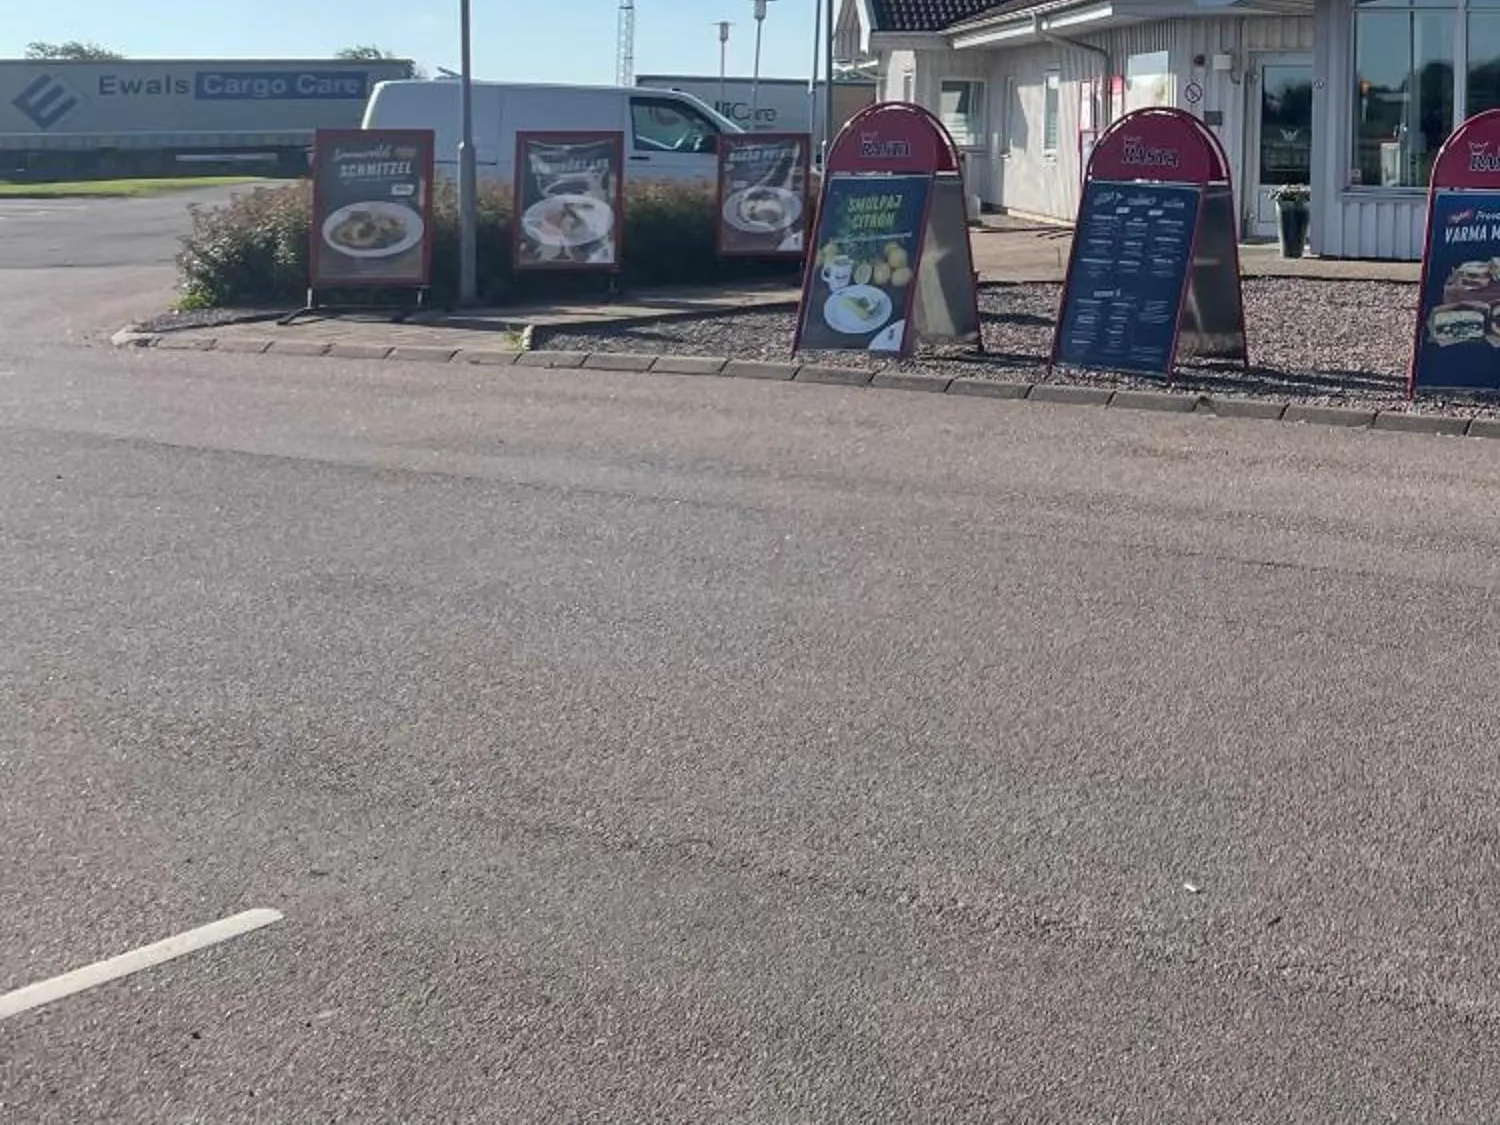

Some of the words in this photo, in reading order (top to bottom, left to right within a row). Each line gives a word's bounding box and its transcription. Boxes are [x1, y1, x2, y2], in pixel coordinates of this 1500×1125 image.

[99, 74, 189, 96] Ewals
[202, 75, 287, 95] Cargo
[295, 75, 360, 94] Care
[340, 161, 412, 177] SCHNITZEL
[1445, 223, 1487, 244] VARMA
